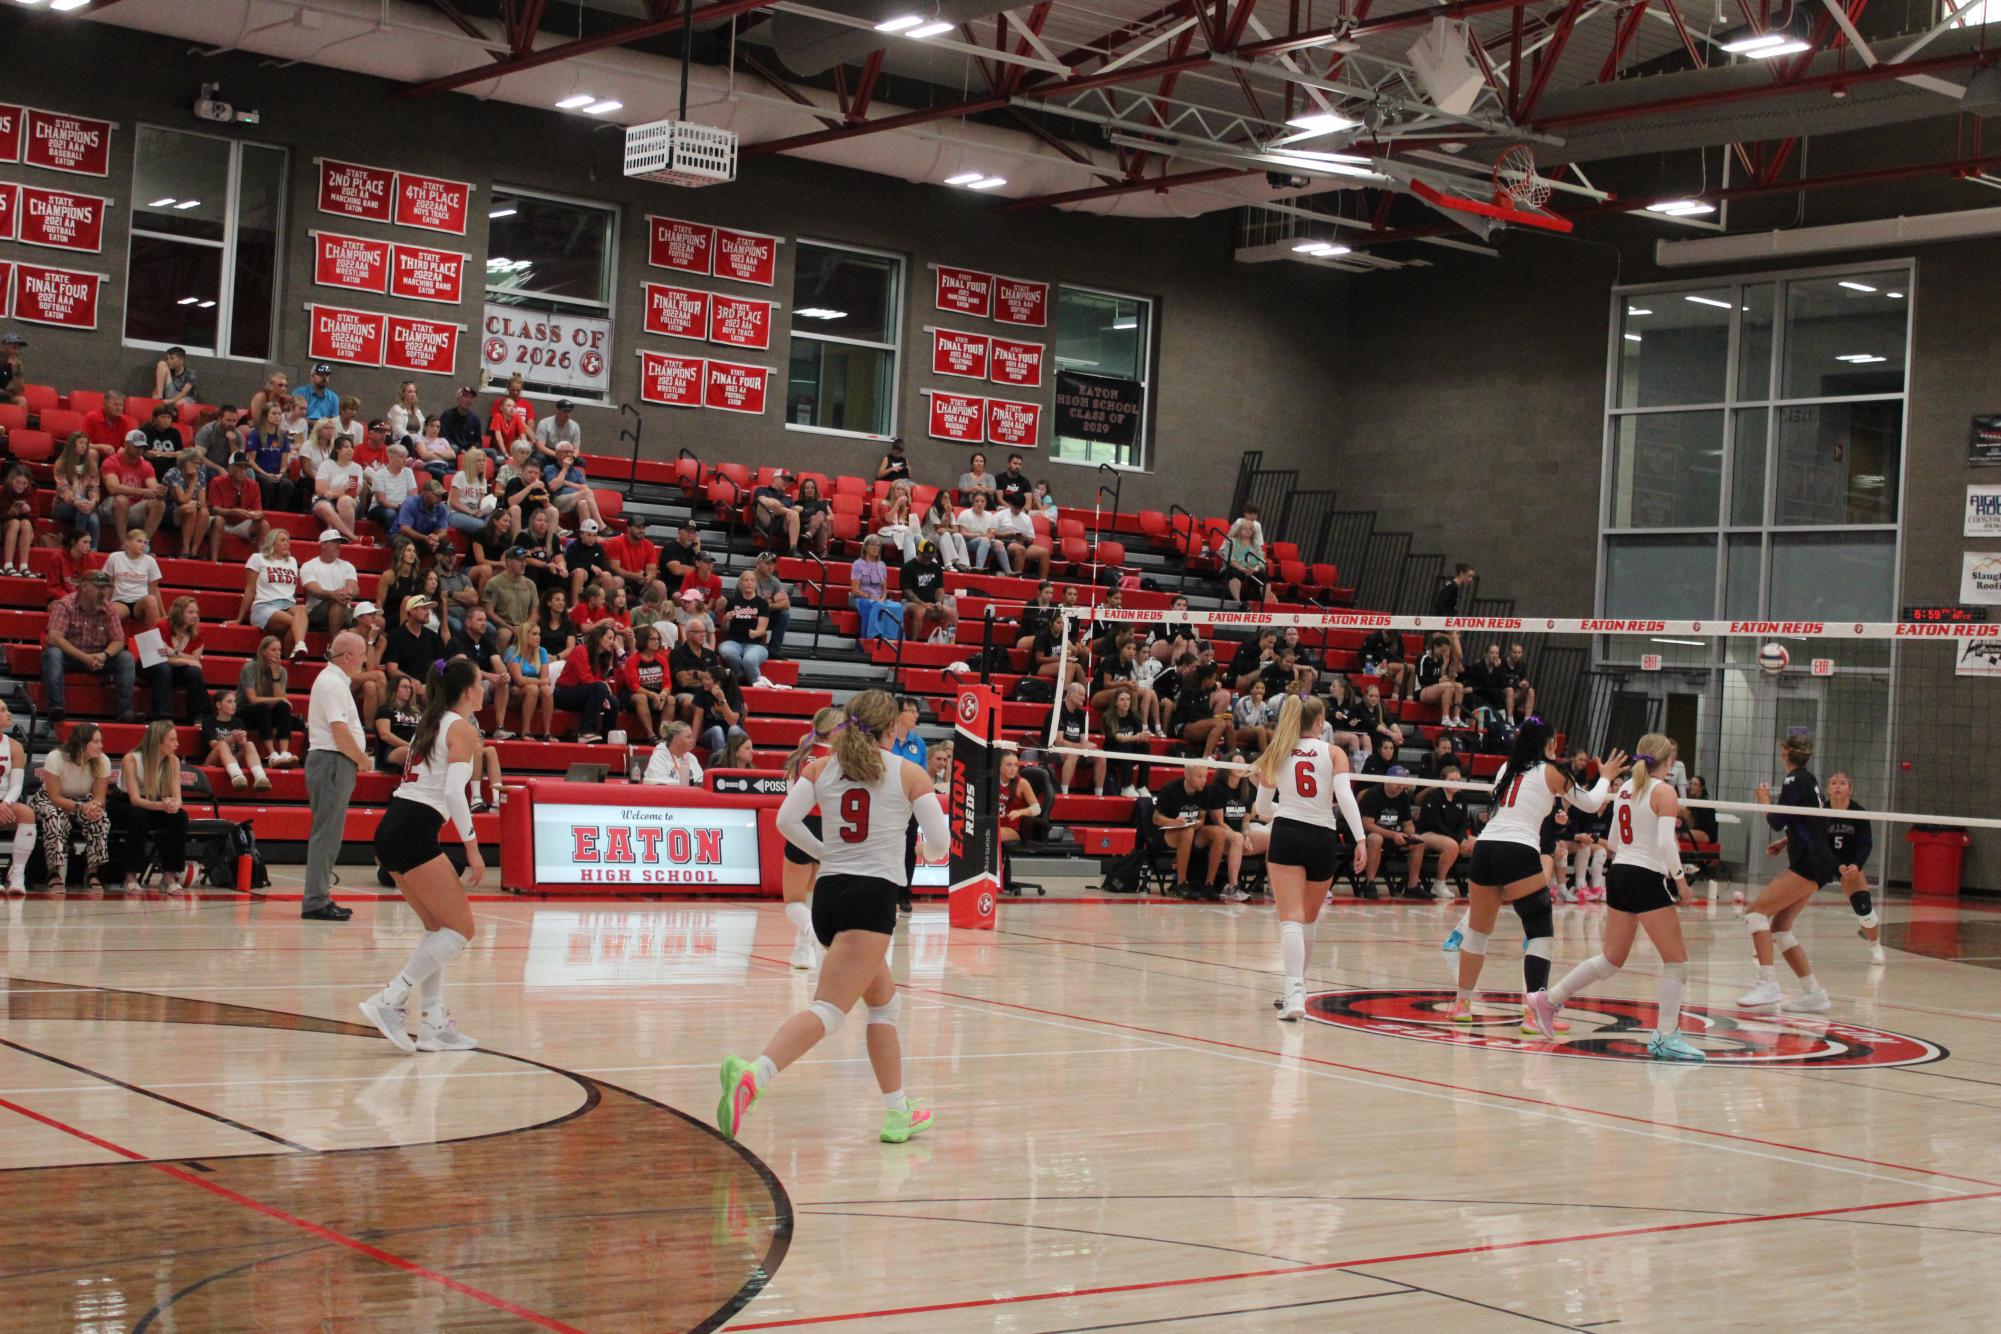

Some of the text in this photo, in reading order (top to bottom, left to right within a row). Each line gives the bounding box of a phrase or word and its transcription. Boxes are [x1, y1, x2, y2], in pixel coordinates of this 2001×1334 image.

[55, 119, 80, 130] STATE
[36, 121, 99, 147] CHAMPIONS
[48, 139, 85, 153] 2021 AAA
[49, 148, 83, 160] BASEBALL
[55, 157, 75, 166] EATON
[346, 169, 368, 179] STATE
[329, 171, 384, 196] 2ND PLACE
[423, 182, 444, 192] STATE
[342, 187, 369, 199] 2021 AA
[406, 185, 459, 208] 4TH PLACE
[48, 196, 74, 206] STATE
[331, 193, 378, 209] MARCHING BAND
[30, 198, 92, 224] CHAMPIONS
[345, 203, 362, 213] EATON
[414, 208, 448, 219] BOYS TRACK
[44, 216, 75, 228] 2021 AA
[423, 216, 439, 224] EATON
[43, 225, 76, 236] FOOTBALL
[673, 225, 692, 234] STATE
[49, 234, 68, 242] EATON
[659, 227, 706, 249] CHAMPIONS
[737, 237, 755, 246] STATE
[343, 241, 364, 250] STATE
[722, 239, 767, 260] CHAMPIONS
[326, 243, 380, 266] CHAMPIONS
[419, 252, 440, 262] STATE
[400, 255, 457, 277] THIRD PLACE
[731, 262, 755, 272] BASEBALL
[746, 257, 757, 266] AAA
[45, 272, 70, 284] STATE
[336, 267, 368, 278] WRESTLING
[343, 276, 360, 284] EATON
[403, 277, 451, 290] MARCHING BAND
[942, 275, 964, 288] FINAL
[966, 282, 986, 295] FOUR
[26, 276, 88, 301] FINAL FOUR
[419, 287, 435, 295] EATON
[1001, 286, 1041, 303] CHAMPIONS
[38, 293, 73, 306] 2021 AAA
[668, 291, 688, 300] STATE
[39, 302, 72, 313] SOFTBALL
[653, 294, 701, 316] FINAL FOUR
[731, 303, 750, 311] STATE
[45, 310, 64, 319] EATON
[338, 314, 359, 323] STATE
[717, 305, 762, 324] 3RD PLACE
[321, 317, 375, 339] CHAMPIONS
[661, 317, 691, 327] VOLLEYBALL
[725, 320, 752, 330] 2023 AAA
[412, 324, 433, 333] STATE
[486, 316, 604, 348] CLASS OF
[395, 326, 448, 348] CHAMPIONS
[332, 341, 361, 351] BASEBALL
[939, 338, 961, 351] FINAL
[964, 344, 984, 356] FOUR
[406, 350, 434, 360] SOFTBALL
[516, 345, 571, 369] 2026
[994, 347, 1017, 360] FINAL
[1019, 354, 1039, 365] FOUR
[411, 358, 427, 366] EATON
[664, 360, 683, 368] STATE
[649, 362, 697, 381] CHAMPIONS
[658, 377, 686, 387] 2023 AAA
[711, 371, 761, 390] FINAL FOUR
[657, 385, 686, 394] WRESTLING
[1079, 385, 1119, 399] EATON
[937, 400, 978, 418] CHAMPIONS
[1057, 394, 1138, 414] HIGH SCHOOL
[992, 408, 1033, 425] FINAL FOUR
[1069, 408, 1125, 424] CLASS OF
[1104, 610, 1163, 620] EATON REDS
[1208, 612, 1272, 623] EATON REDS
[1914, 609, 1941, 619] 6:59
[1321, 616, 1391, 626] EATON REDS
[1445, 618, 1521, 628] EATON REDS
[1581, 620, 1664, 631] EATON REDS
[1730, 622, 1823, 634] EATON REDS
[1895, 624, 1999, 636] EATON REDS
[1644, 656, 1657, 669] EXIT
[1814, 660, 1828, 674] EXIT
[639, 666, 661, 675] EATON
[1291, 749, 1318, 758] Reds
[1295, 761, 1317, 798] 6
[950, 759, 966, 858] EATON
[966, 783, 975, 836] REDS
[620, 810, 674, 820] Welcome to
[840, 788, 870, 844] 9
[1618, 804, 1633, 844] 8
[572, 825, 724, 864] EATON
[1834, 836, 1844, 849] 5
[580, 869, 718, 882] HIGH SCHOOL
